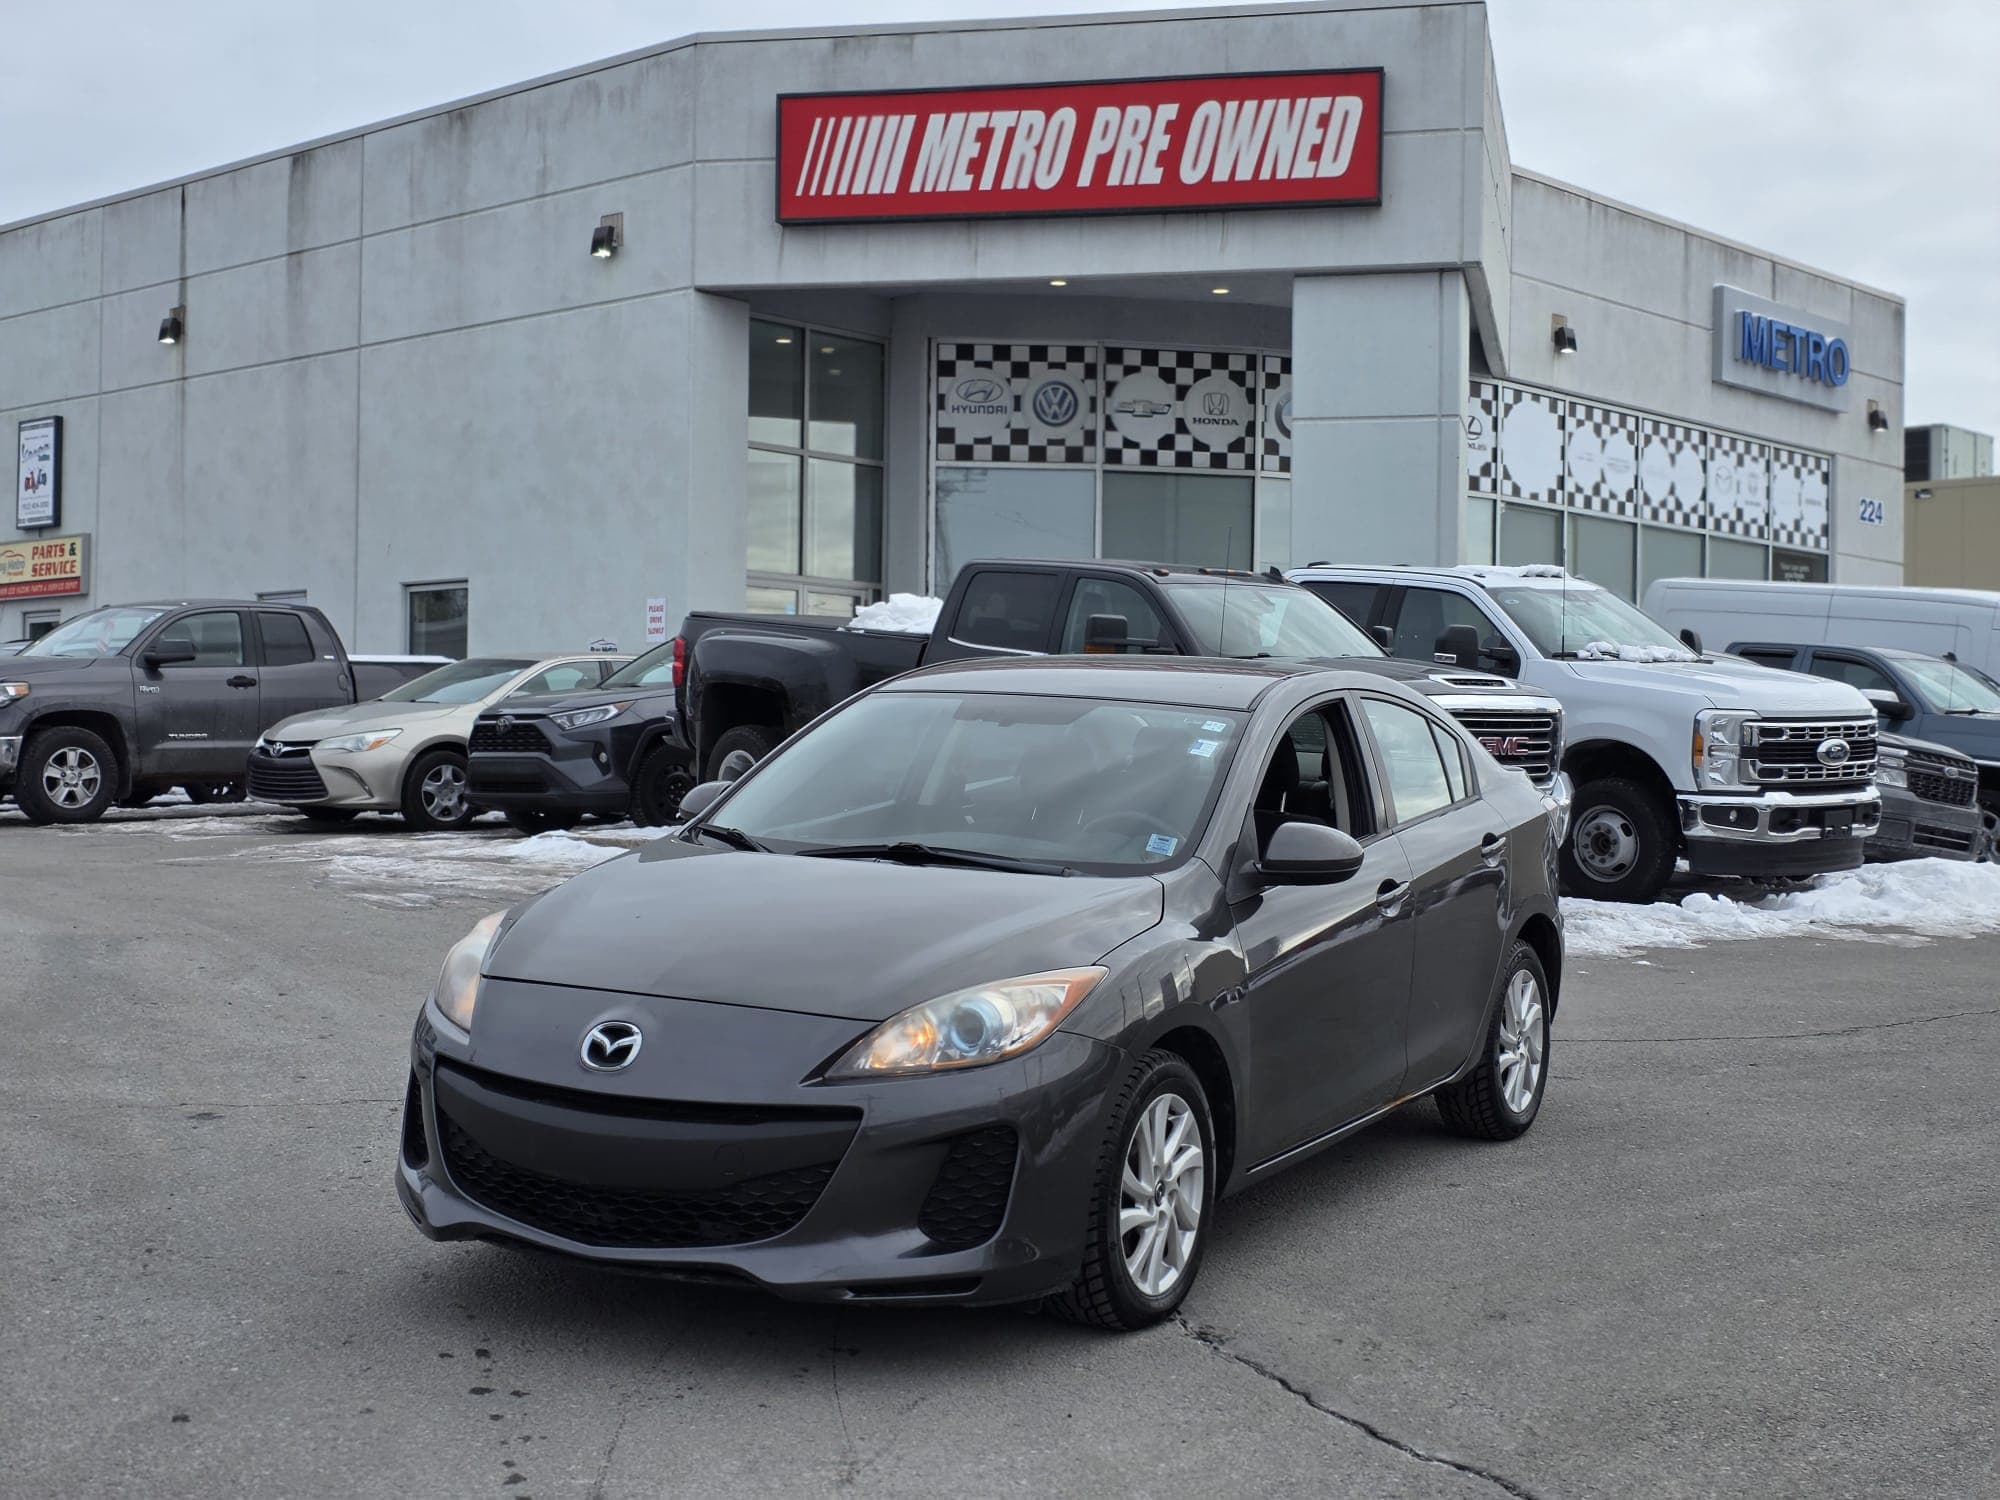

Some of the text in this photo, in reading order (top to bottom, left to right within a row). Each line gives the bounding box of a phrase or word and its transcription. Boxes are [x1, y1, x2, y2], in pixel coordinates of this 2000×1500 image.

[909, 96, 1363, 193] METRO PRE OWNED
[1738, 311, 1850, 386] METRO
[951, 404, 1008, 416] HYUNDAI
[1191, 416, 1239, 427] HONDA
[1859, 498, 1884, 524] 224
[31, 542, 77, 560] PARTS &
[31, 559, 77, 578] SERVICE
[648, 605, 664, 613] PLEASE
[649, 616, 662, 624] DRIVE
